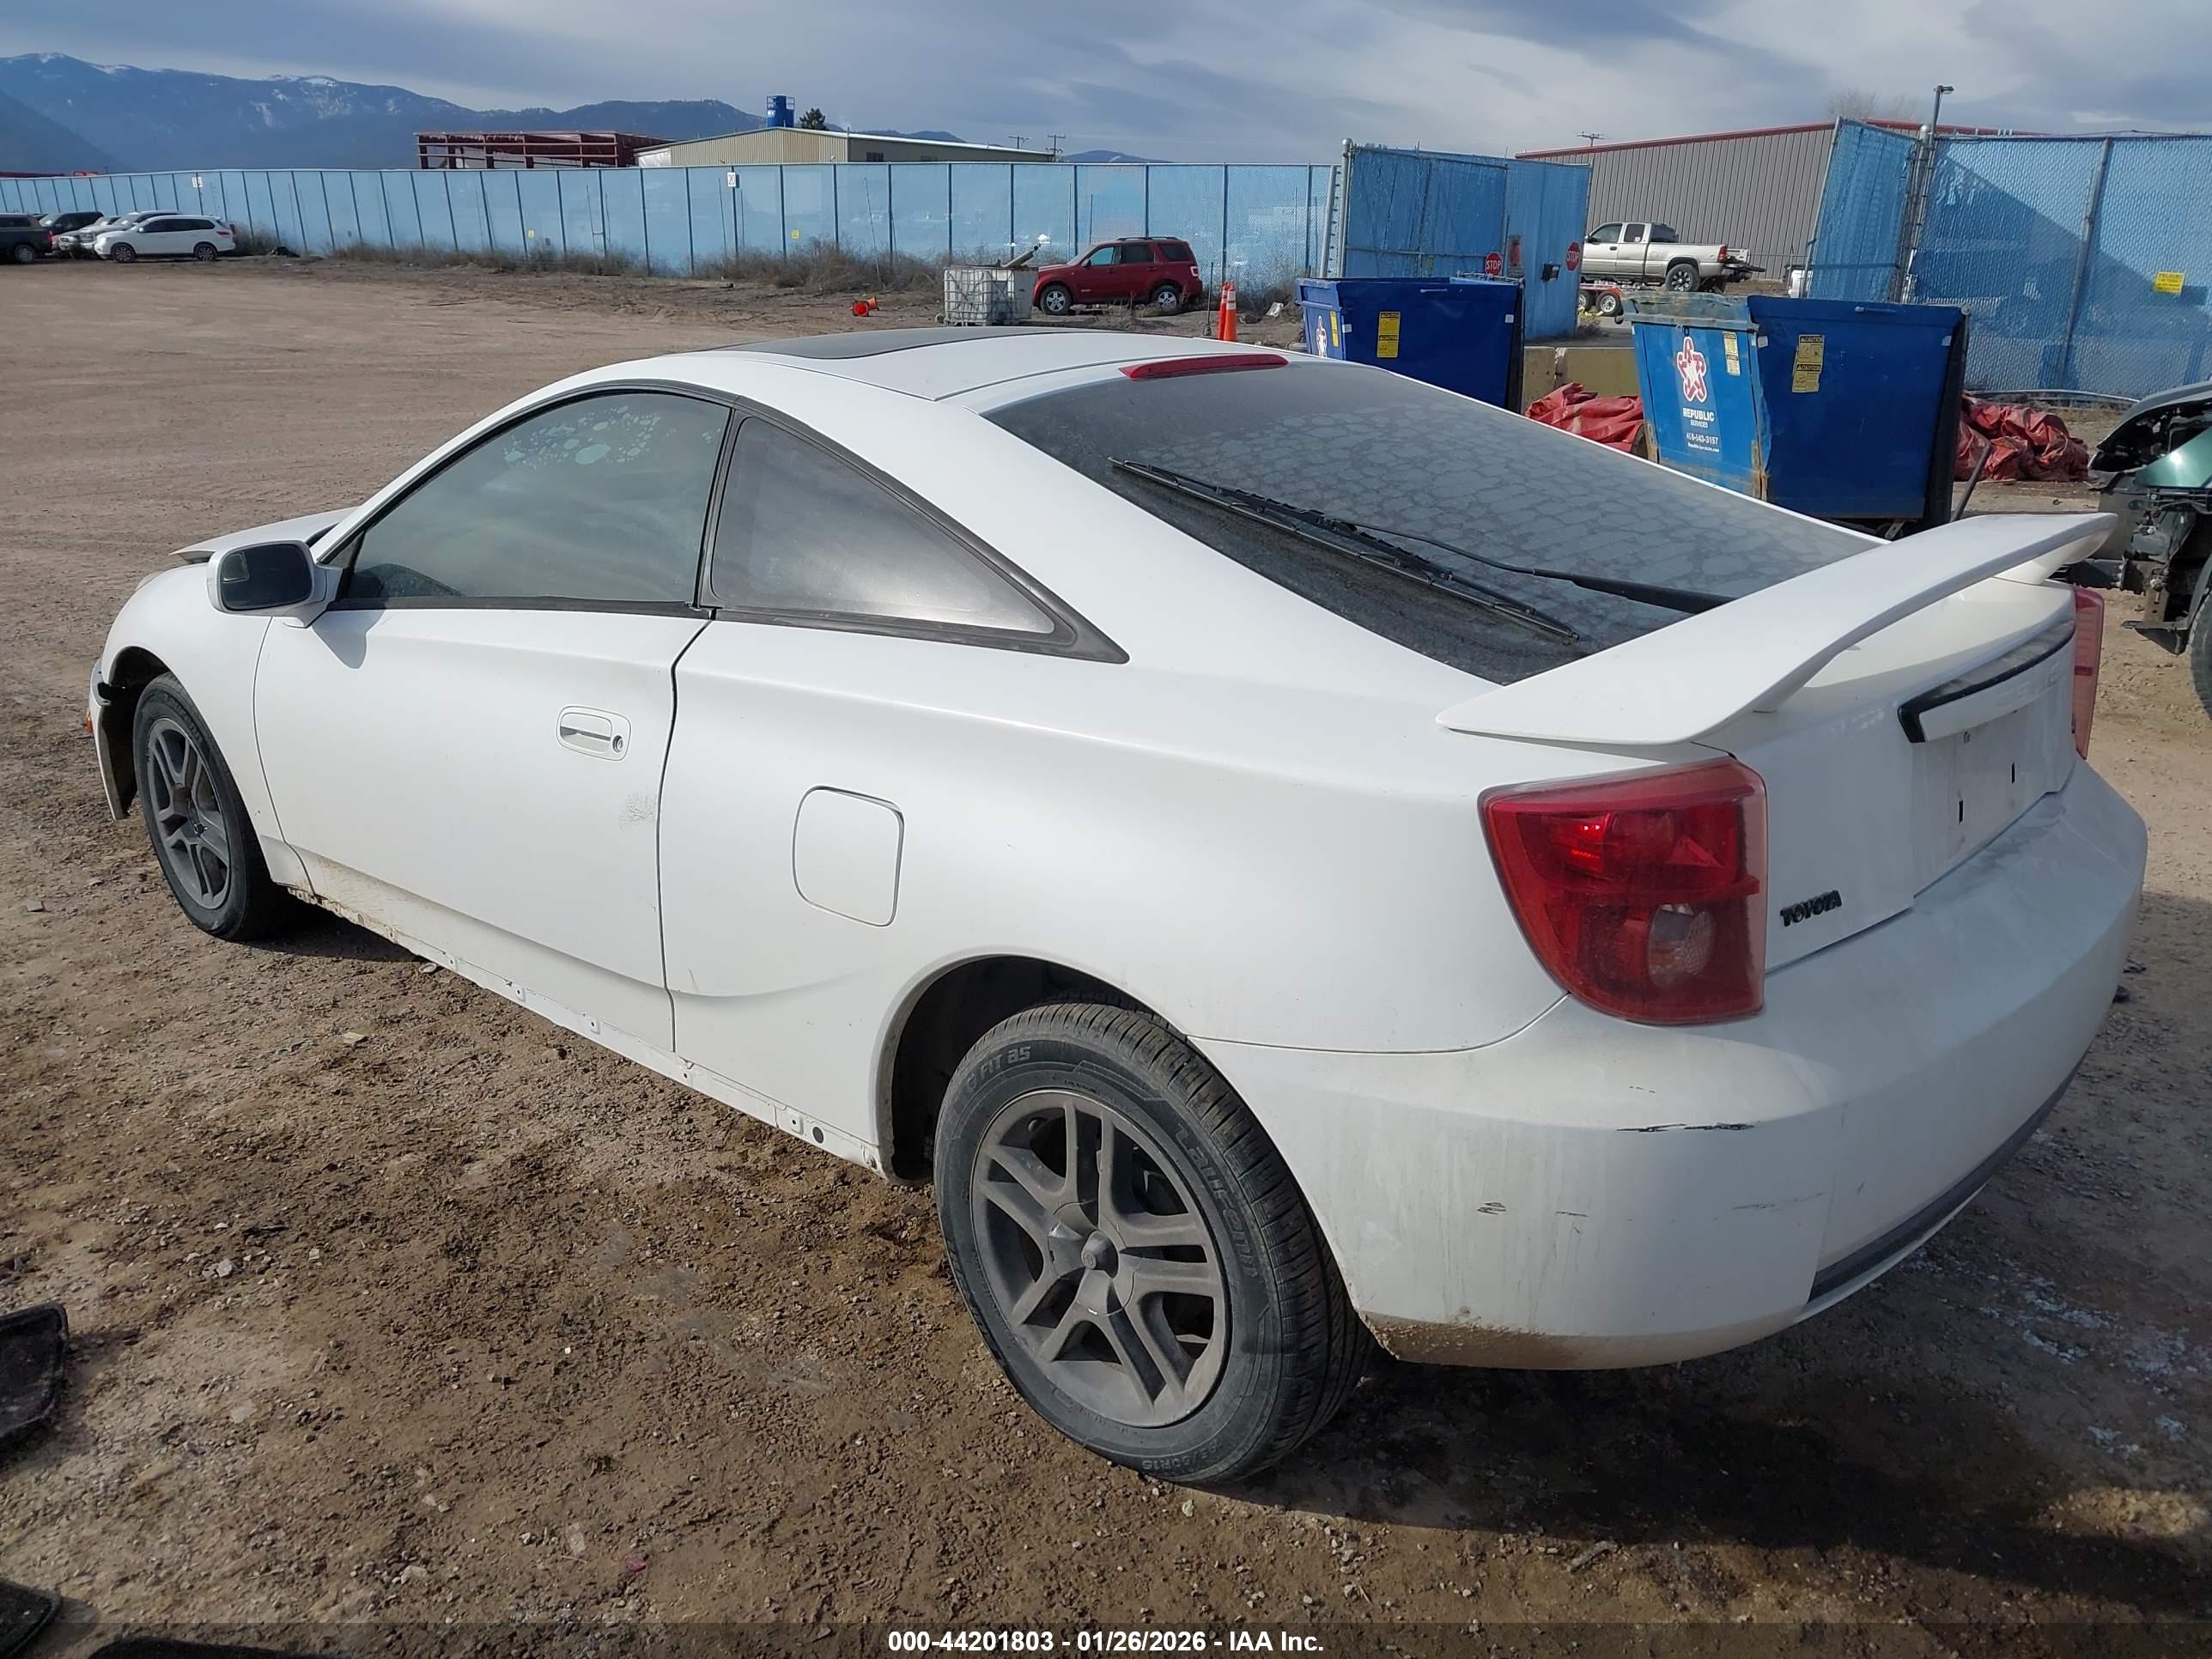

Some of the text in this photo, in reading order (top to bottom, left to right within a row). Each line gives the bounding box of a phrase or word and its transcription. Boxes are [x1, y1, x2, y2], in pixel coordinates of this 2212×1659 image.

[1565, 250, 1581, 262] STOP
[1486, 259, 1502, 270] STOP
[1682, 407, 1715, 422] REPUBLIC
[1780, 890, 1843, 927] TOYOTA
[980, 1053, 1003, 1080] FIT
